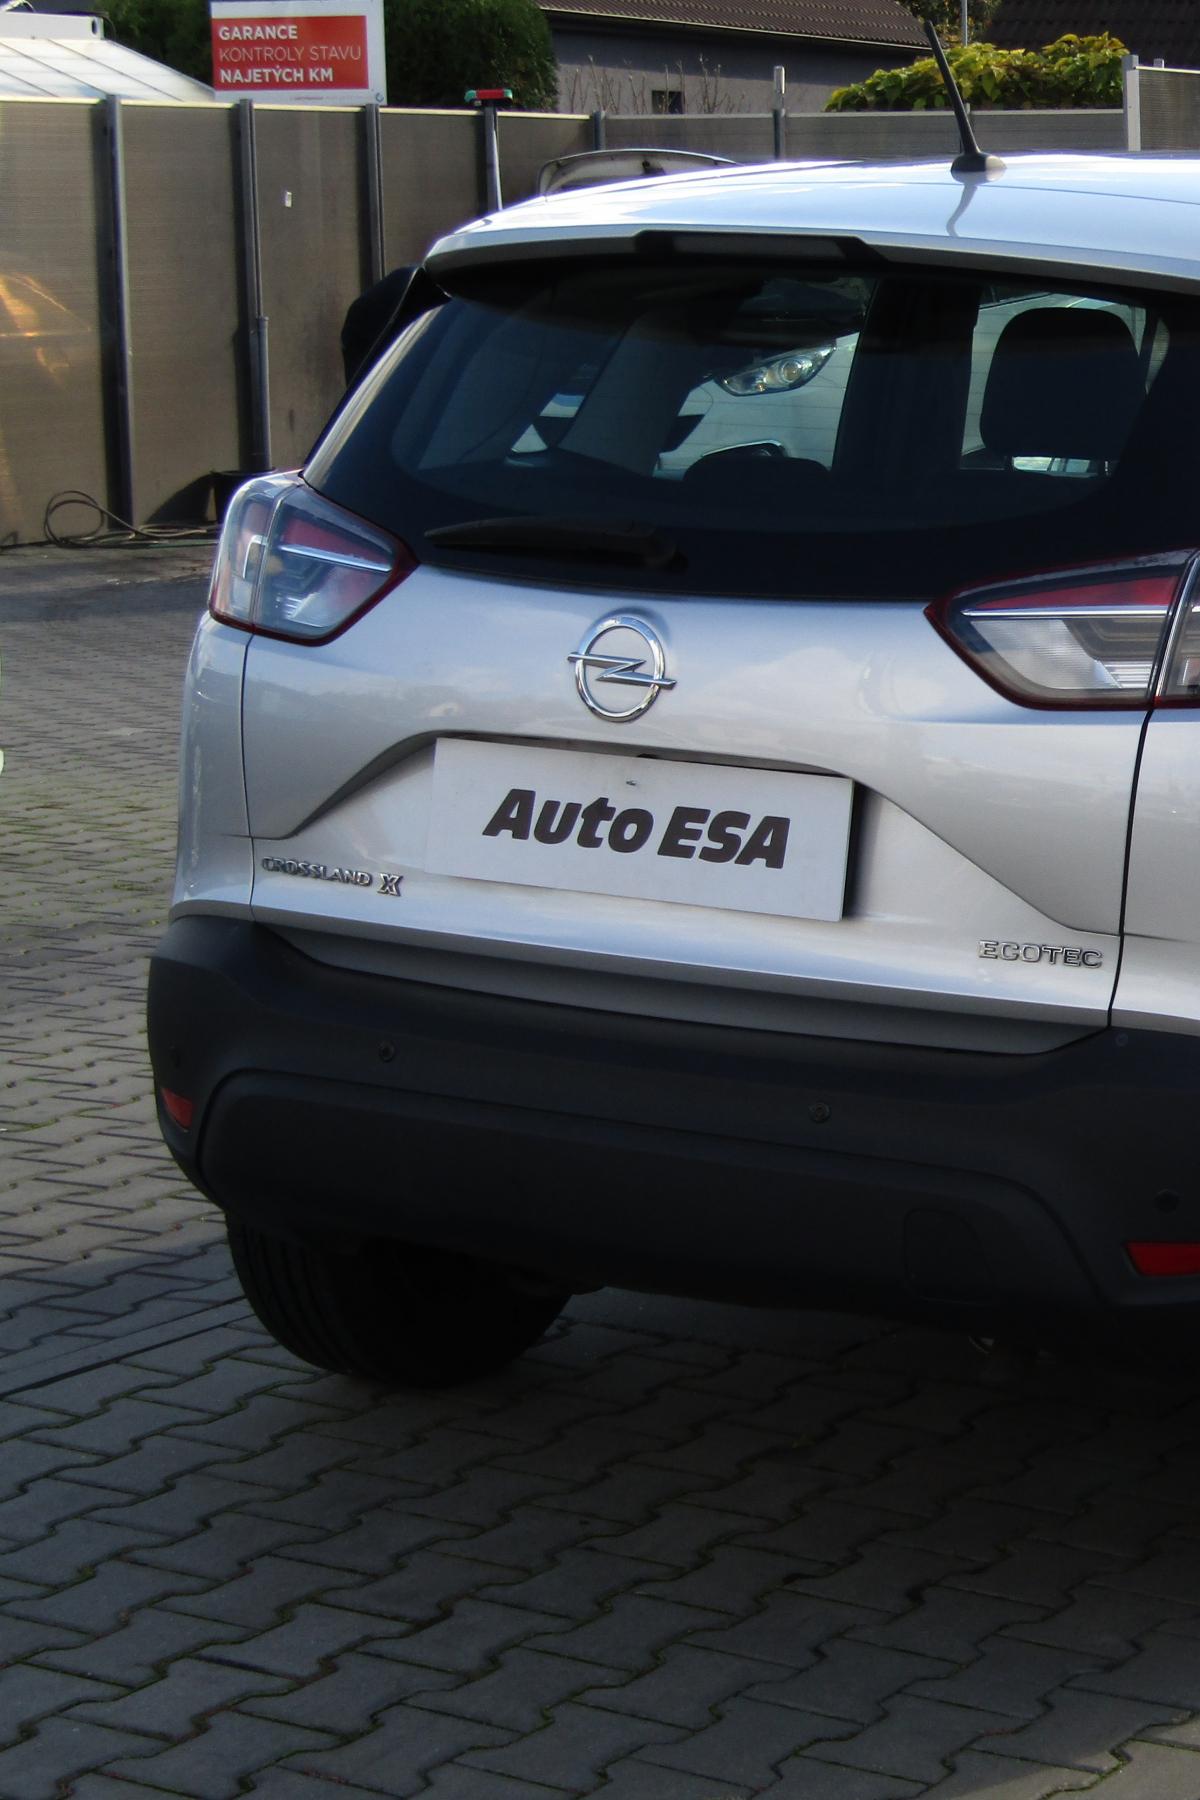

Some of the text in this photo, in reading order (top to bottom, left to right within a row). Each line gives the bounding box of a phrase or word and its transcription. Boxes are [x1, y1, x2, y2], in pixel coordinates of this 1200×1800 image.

[219, 25, 298, 41] GARANCE
[219, 45, 362, 63] KONTROLY STAVU
[220, 65, 334, 83] NAJETÝCH KM
[481, 788, 792, 871] Auto ESA
[261, 856, 404, 897] CROSSLAND X
[978, 939, 1104, 969] ECOTEC
